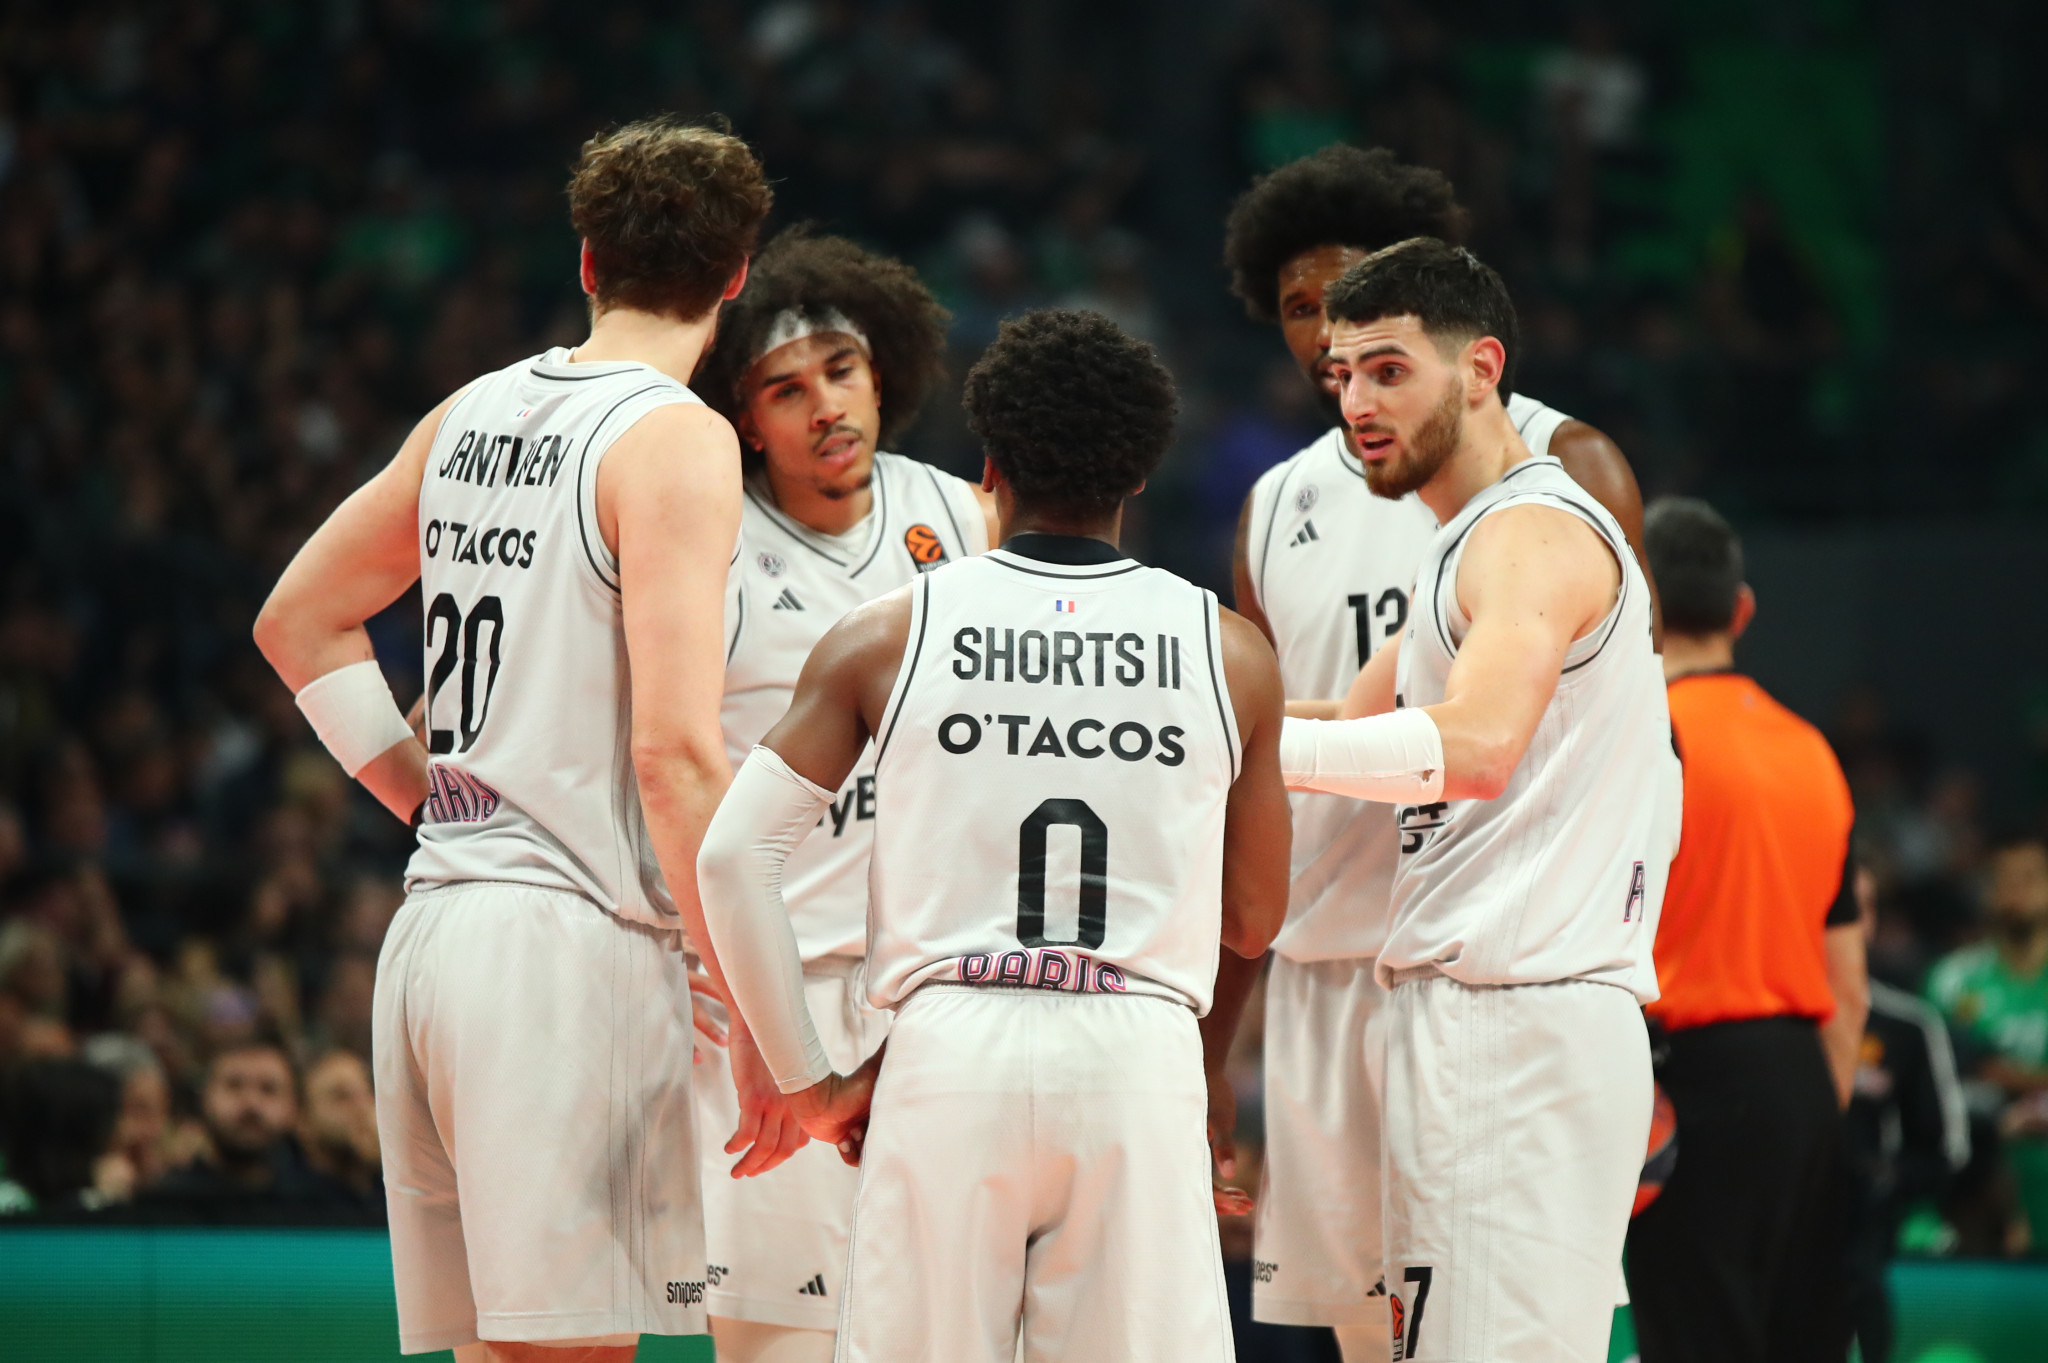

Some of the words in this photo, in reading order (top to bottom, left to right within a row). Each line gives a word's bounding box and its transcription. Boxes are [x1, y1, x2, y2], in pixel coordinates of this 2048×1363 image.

[425, 518, 536, 569] O'TACOS
[426, 592, 504, 755] 20
[952, 626, 1145, 688] SHORTS
[1157, 633, 1181, 690] II
[937, 713, 1186, 767] O'TACOS
[1016, 798, 1108, 951] 0
[1404, 1266, 1433, 1359] 7
